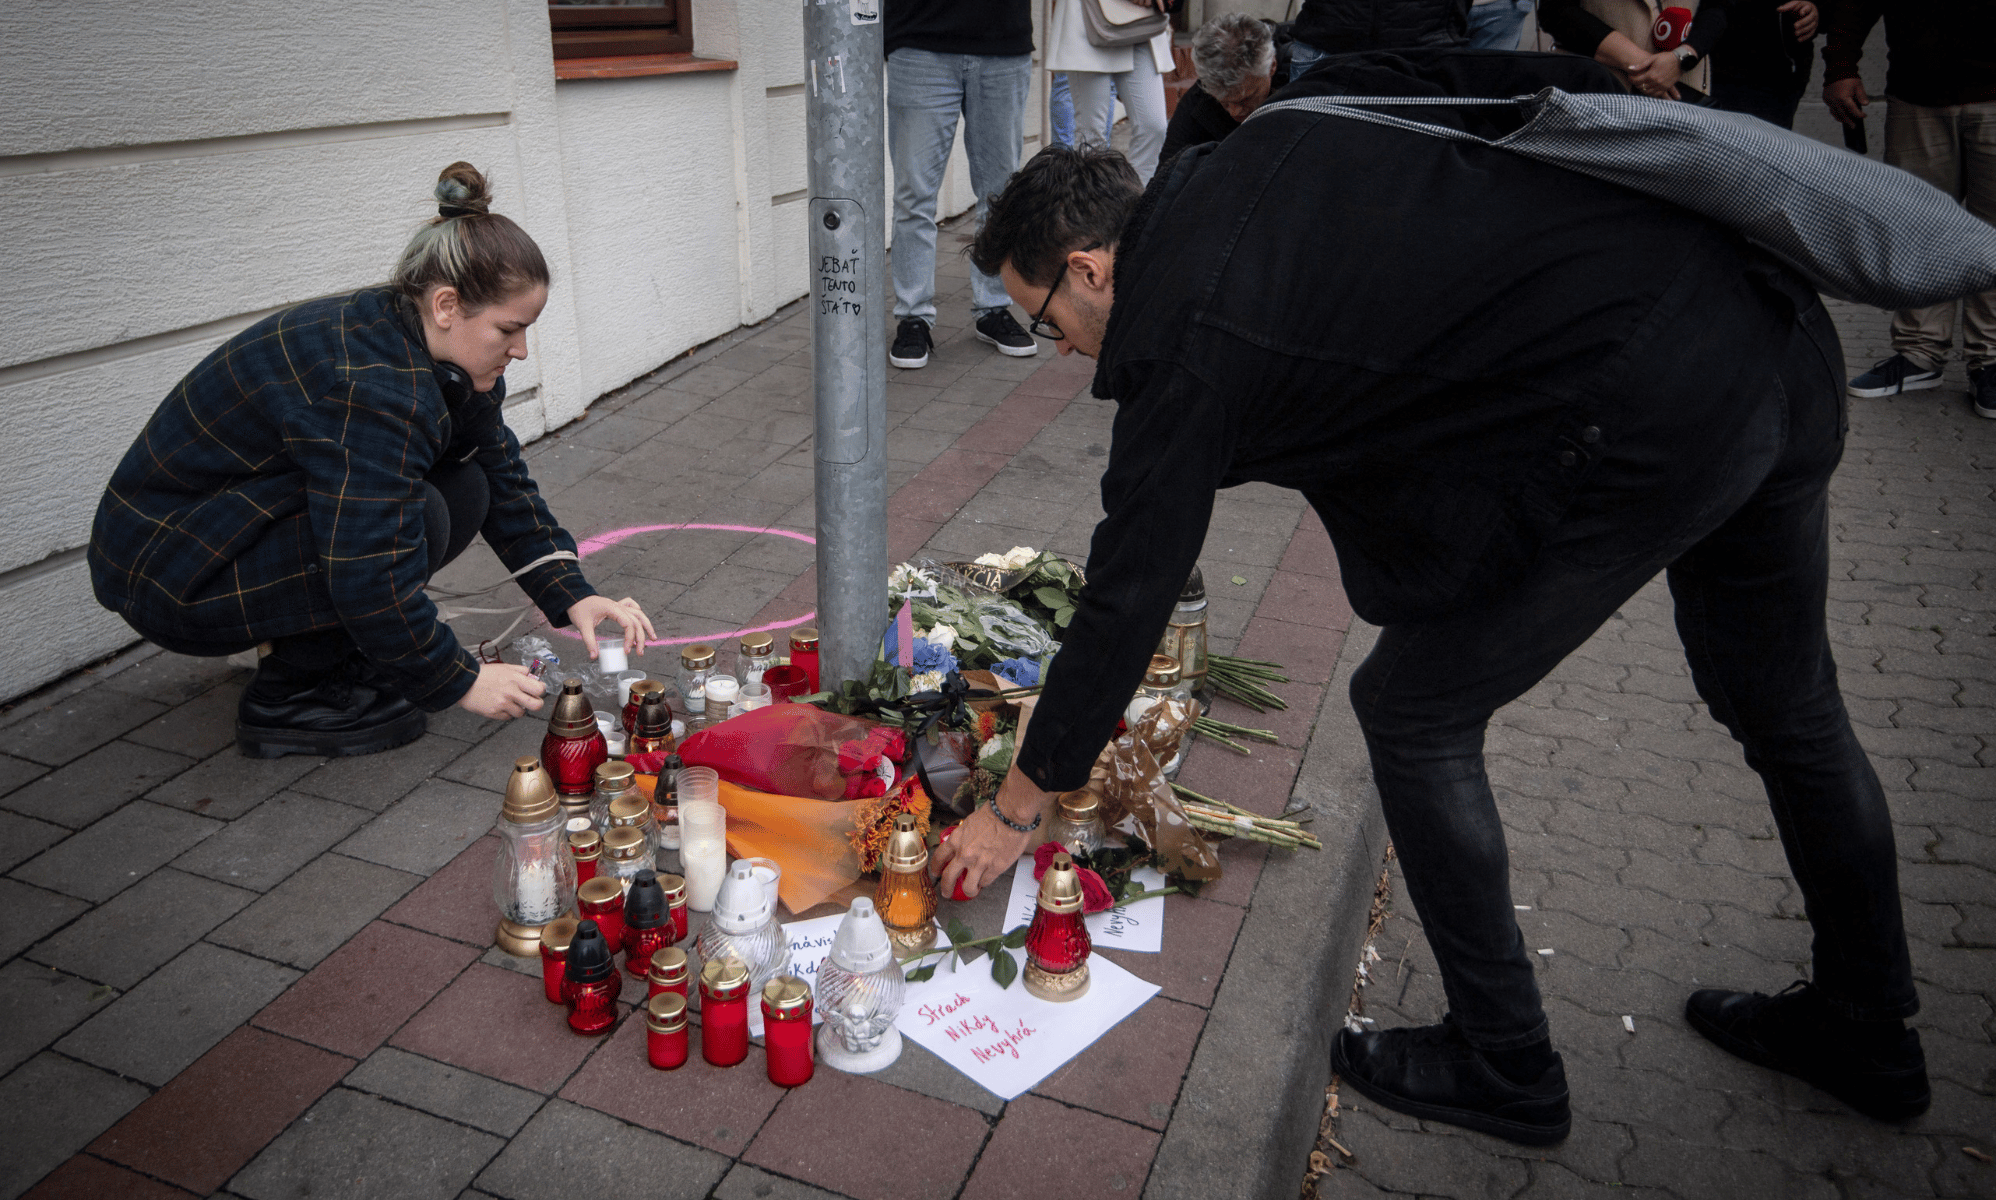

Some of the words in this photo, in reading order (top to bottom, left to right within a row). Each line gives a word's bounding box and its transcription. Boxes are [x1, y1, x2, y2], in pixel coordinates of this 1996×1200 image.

[818, 248, 860, 275] JEBAŤ
[822, 276, 856, 293] TENTO
[821, 293, 851, 315] ŠTÁT
[918, 992, 971, 1026] Strach
[970, 1018, 1037, 1064] Nevyhrá
